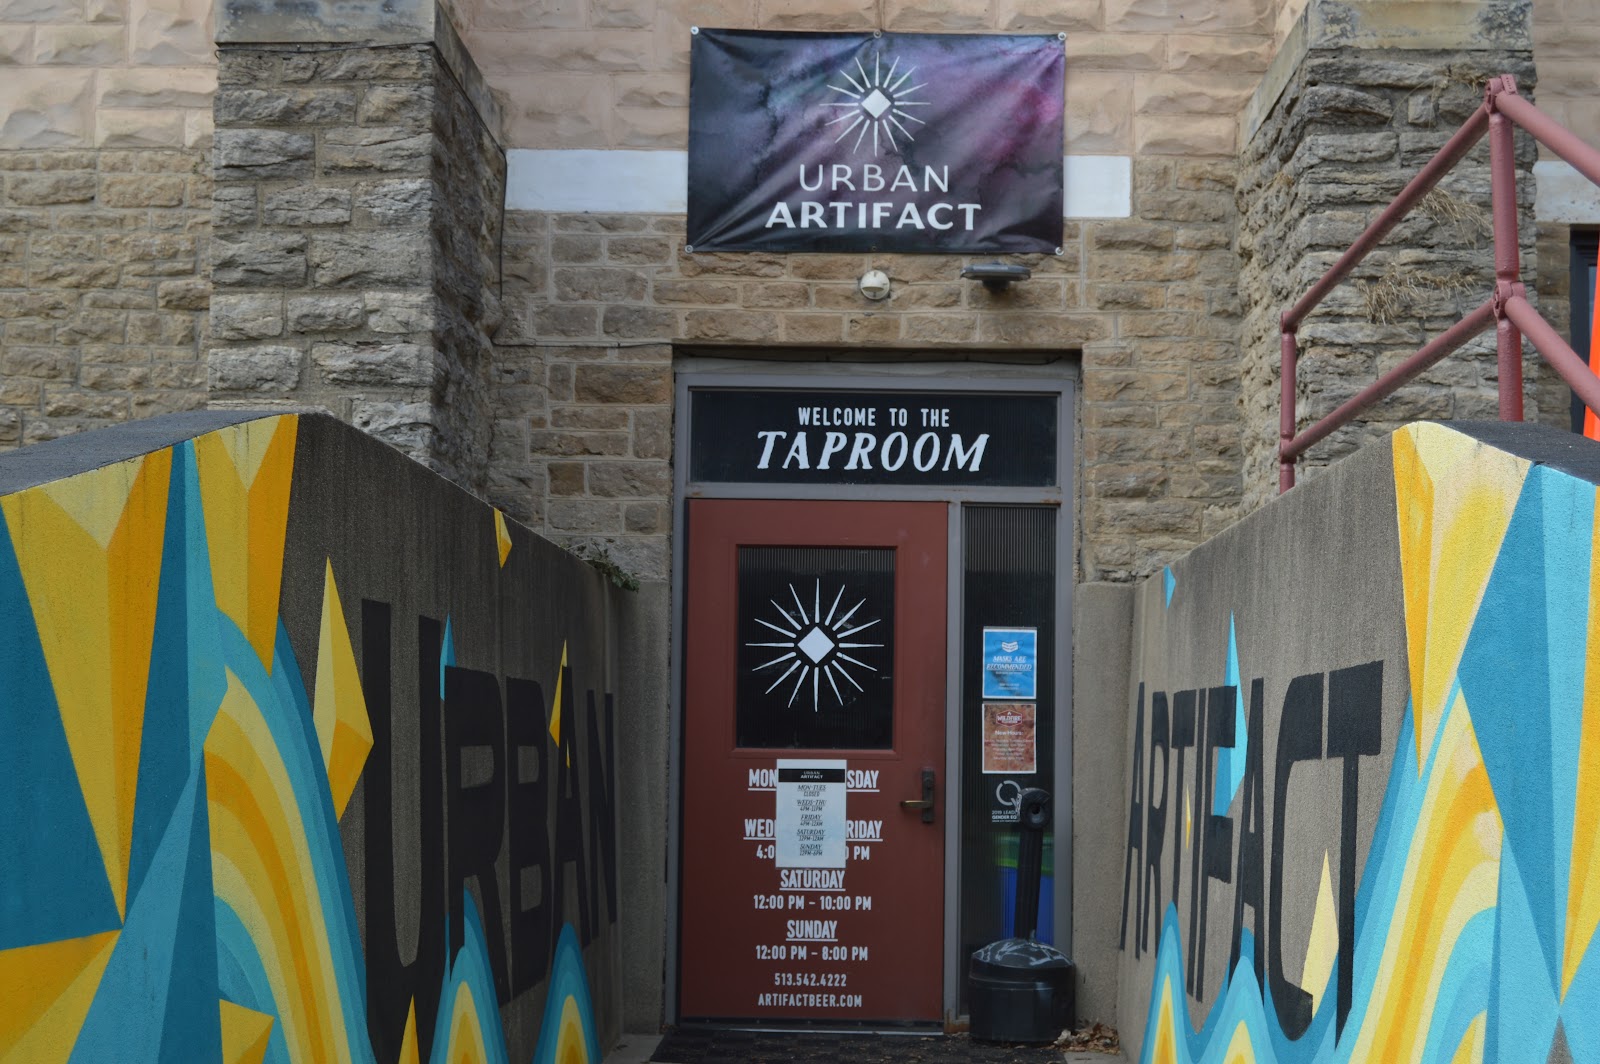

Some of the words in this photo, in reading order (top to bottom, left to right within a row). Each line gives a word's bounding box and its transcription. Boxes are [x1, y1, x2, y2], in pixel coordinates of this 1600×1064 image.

[799, 163, 949, 193] URBAN
[764, 201, 982, 231] ARTIFACT
[798, 406, 877, 426] WELCOME
[889, 407, 909, 427] TO
[920, 408, 950, 428] THE
[756, 430, 991, 473] TAPROOM
[748, 768, 777, 788] MON
[847, 769, 880, 789] SDAY
[361, 597, 617, 1064] URBAN
[846, 820, 883, 839] RIDAY
[756, 844, 776, 859] 4:0
[853, 846, 870, 861] PM
[1119, 659, 1385, 1054] ARTIFACT
[780, 869, 846, 890] SATURDAY
[753, 894, 784, 910] 12:00
[788, 895, 805, 910] PM
[819, 895, 851, 911] 10:00
[855, 896, 872, 911] PM
[786, 919, 838, 940] SUNDAY
[755, 945, 786, 960] 12:00
[790, 945, 807, 960] PM
[821, 946, 848, 961] 8:00
[851, 946, 869, 961] PM
[774, 973, 847, 987] 513.542.4222
[757, 993, 862, 1008] ARTIFACTBEER.COM
